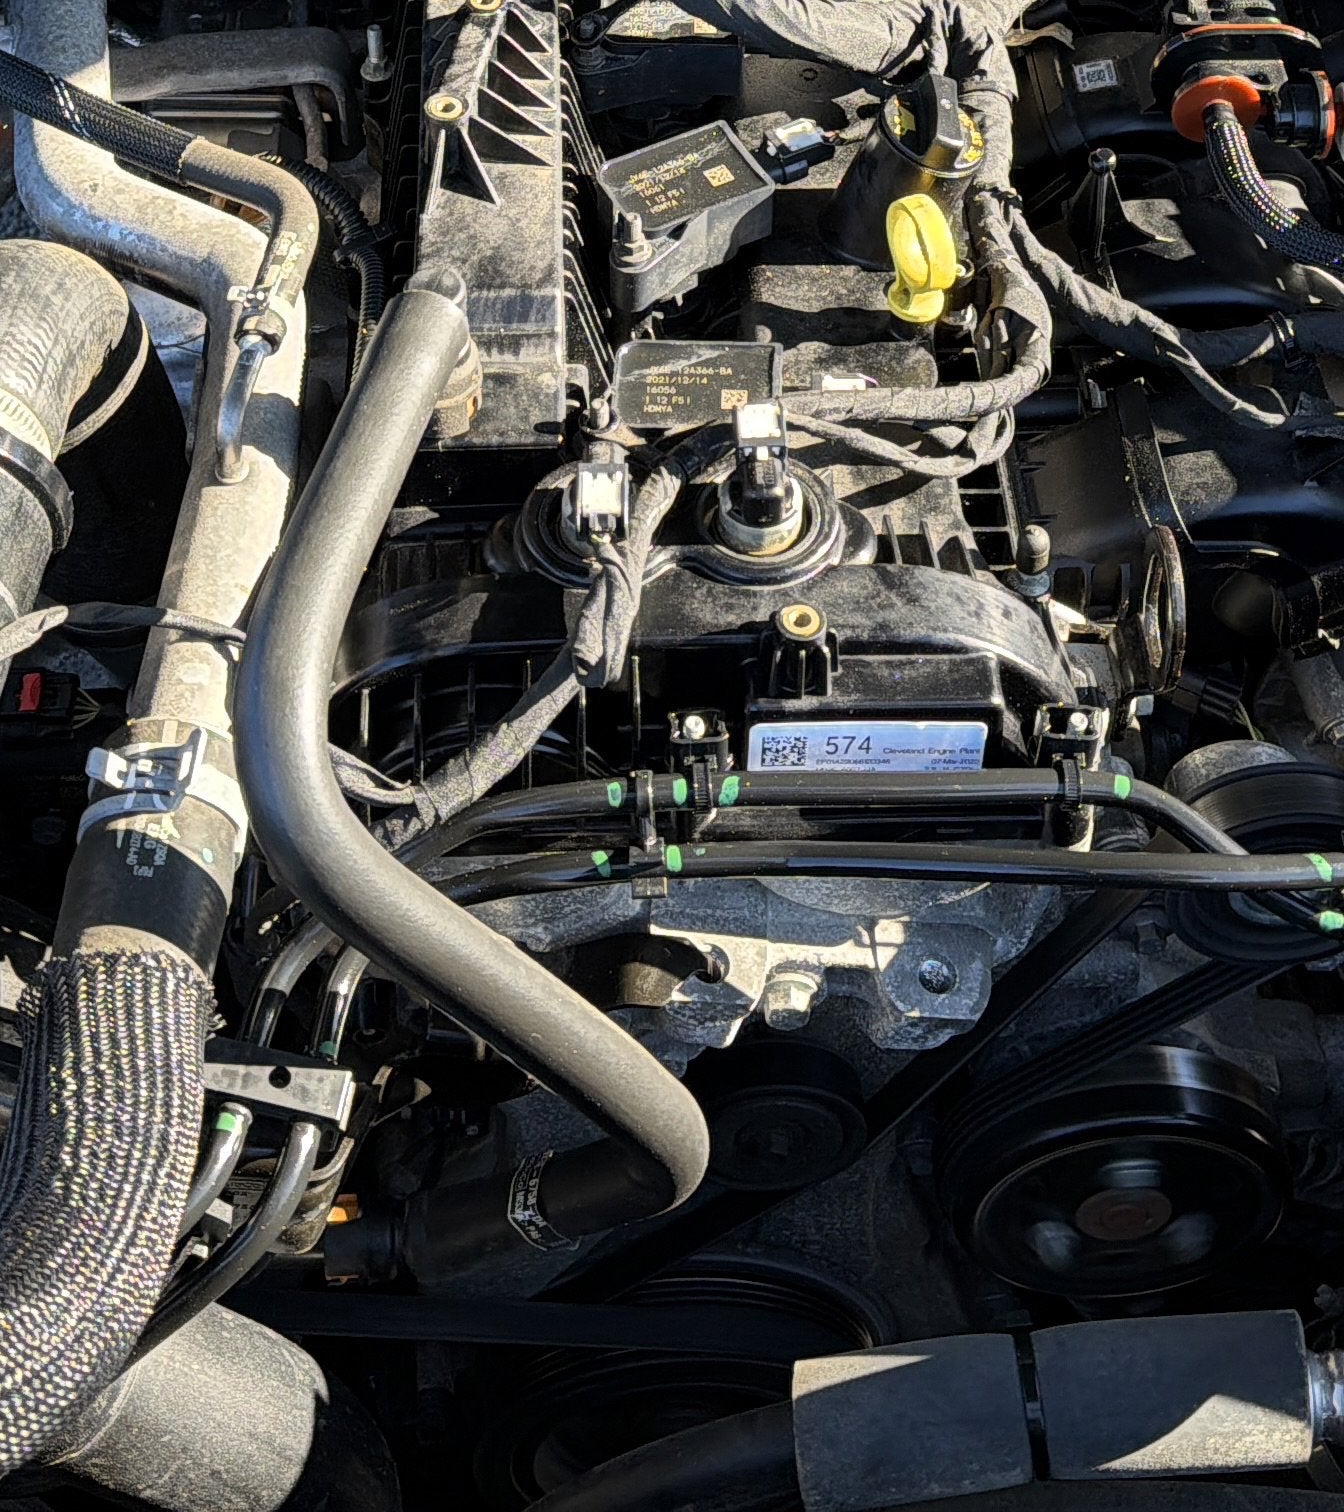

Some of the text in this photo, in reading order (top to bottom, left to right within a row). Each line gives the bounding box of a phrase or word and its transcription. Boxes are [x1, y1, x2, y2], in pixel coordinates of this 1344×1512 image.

[824, 735, 981, 756] 574 Cleveland Engine Plant
